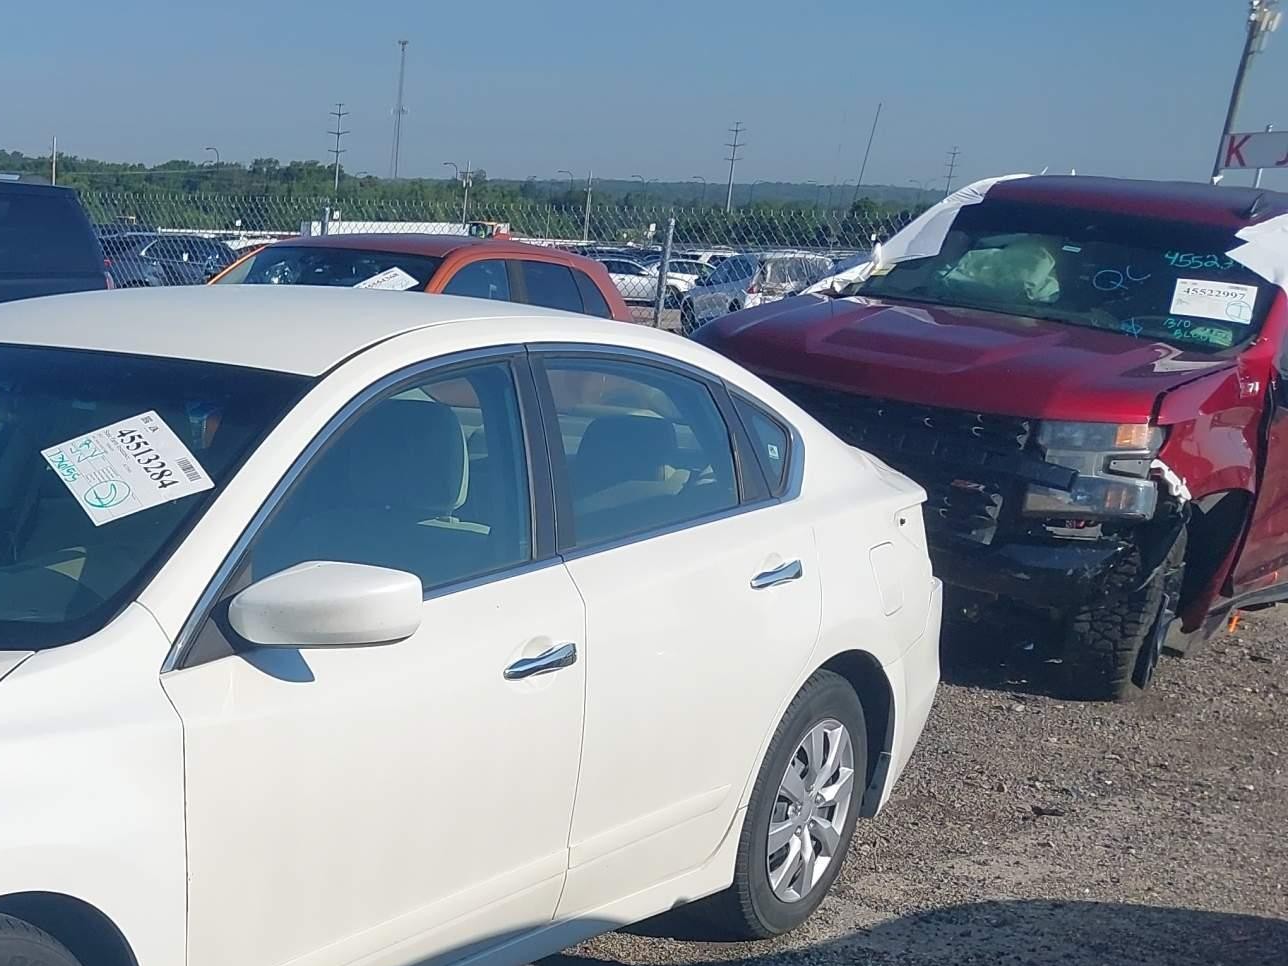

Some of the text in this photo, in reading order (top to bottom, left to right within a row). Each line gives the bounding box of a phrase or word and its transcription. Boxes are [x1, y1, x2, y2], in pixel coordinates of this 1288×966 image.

[1224, 134, 1252, 168] K
[1183, 287, 1246, 300] 45522997
[117, 429, 179, 489] 45513284
